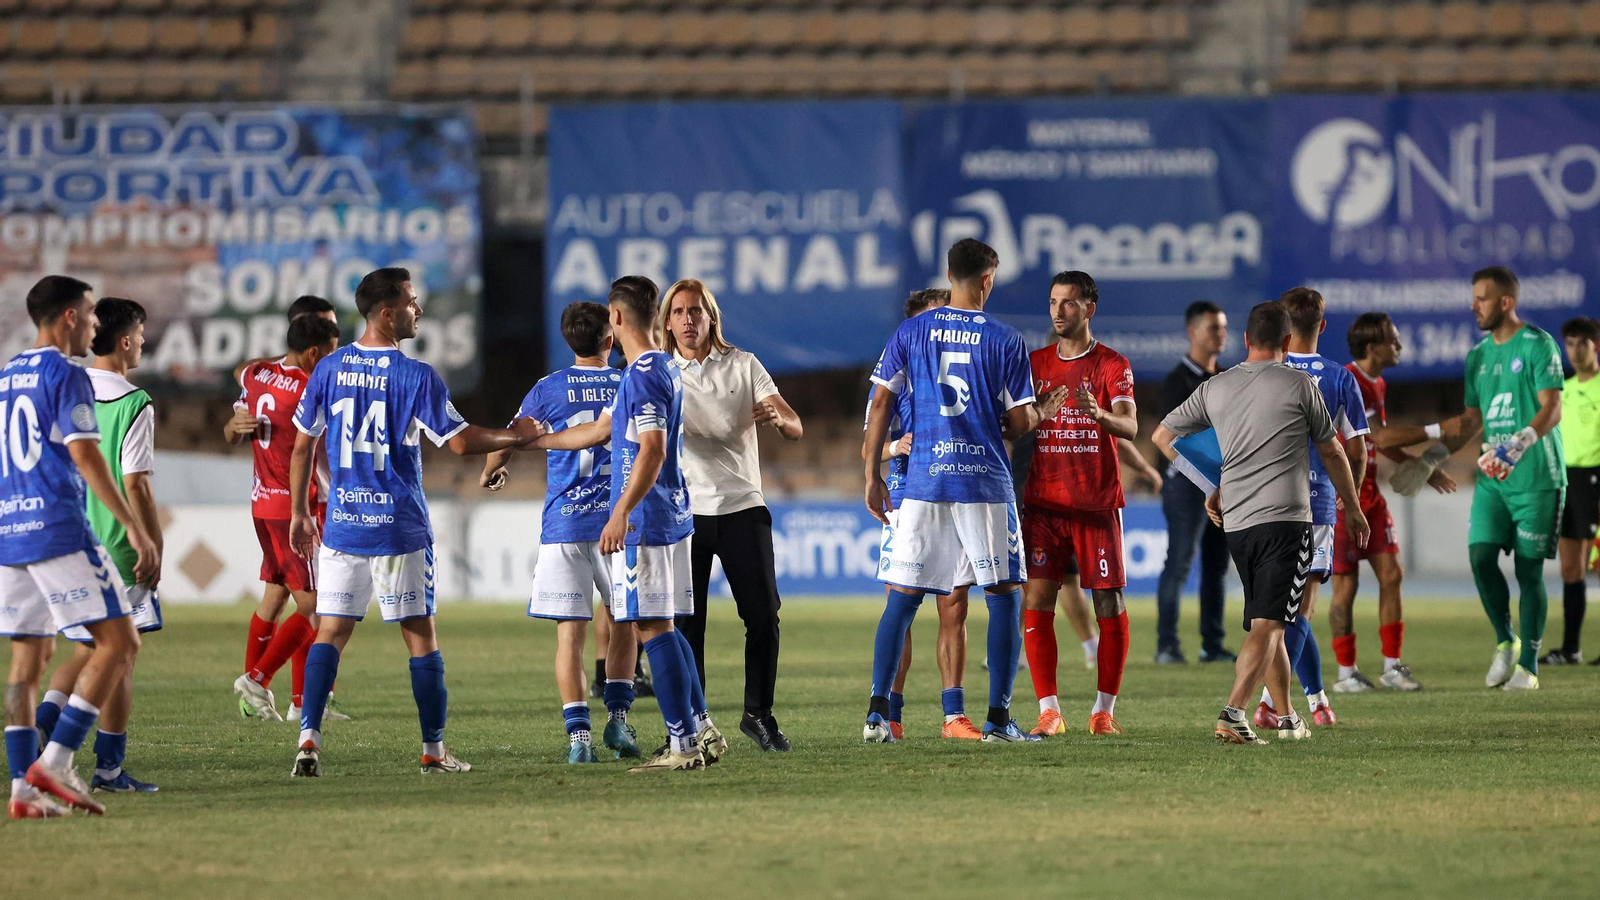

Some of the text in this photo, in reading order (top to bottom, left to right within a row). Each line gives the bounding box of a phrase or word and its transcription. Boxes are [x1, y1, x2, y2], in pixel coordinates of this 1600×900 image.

[0, 113, 297, 158] IUDAD
[553, 190, 902, 236] AUTO-ESCUELA
[552, 235, 900, 295] ARENAL
[934, 312, 970, 323] indeso
[930, 329, 981, 345] MAURO
[336, 371, 388, 392] MORANTE
[567, 374, 608, 384] indeso
[937, 352, 971, 417] 5
[568, 389, 580, 403] D.
[1060, 406, 1082, 416] Rica
[256, 392, 276, 450] 6
[1060, 415, 1098, 425] Fuentes
[330, 397, 390, 471] 14
[1072, 442, 1099, 454] GÓMEZ
[957, 462, 988, 474] benito
[361, 513, 394, 524] benito
[881, 525, 895, 553] 2
[1099, 558, 1109, 578] 9
[50, 586, 90, 605] EYES
[379, 590, 417, 606] REYES
